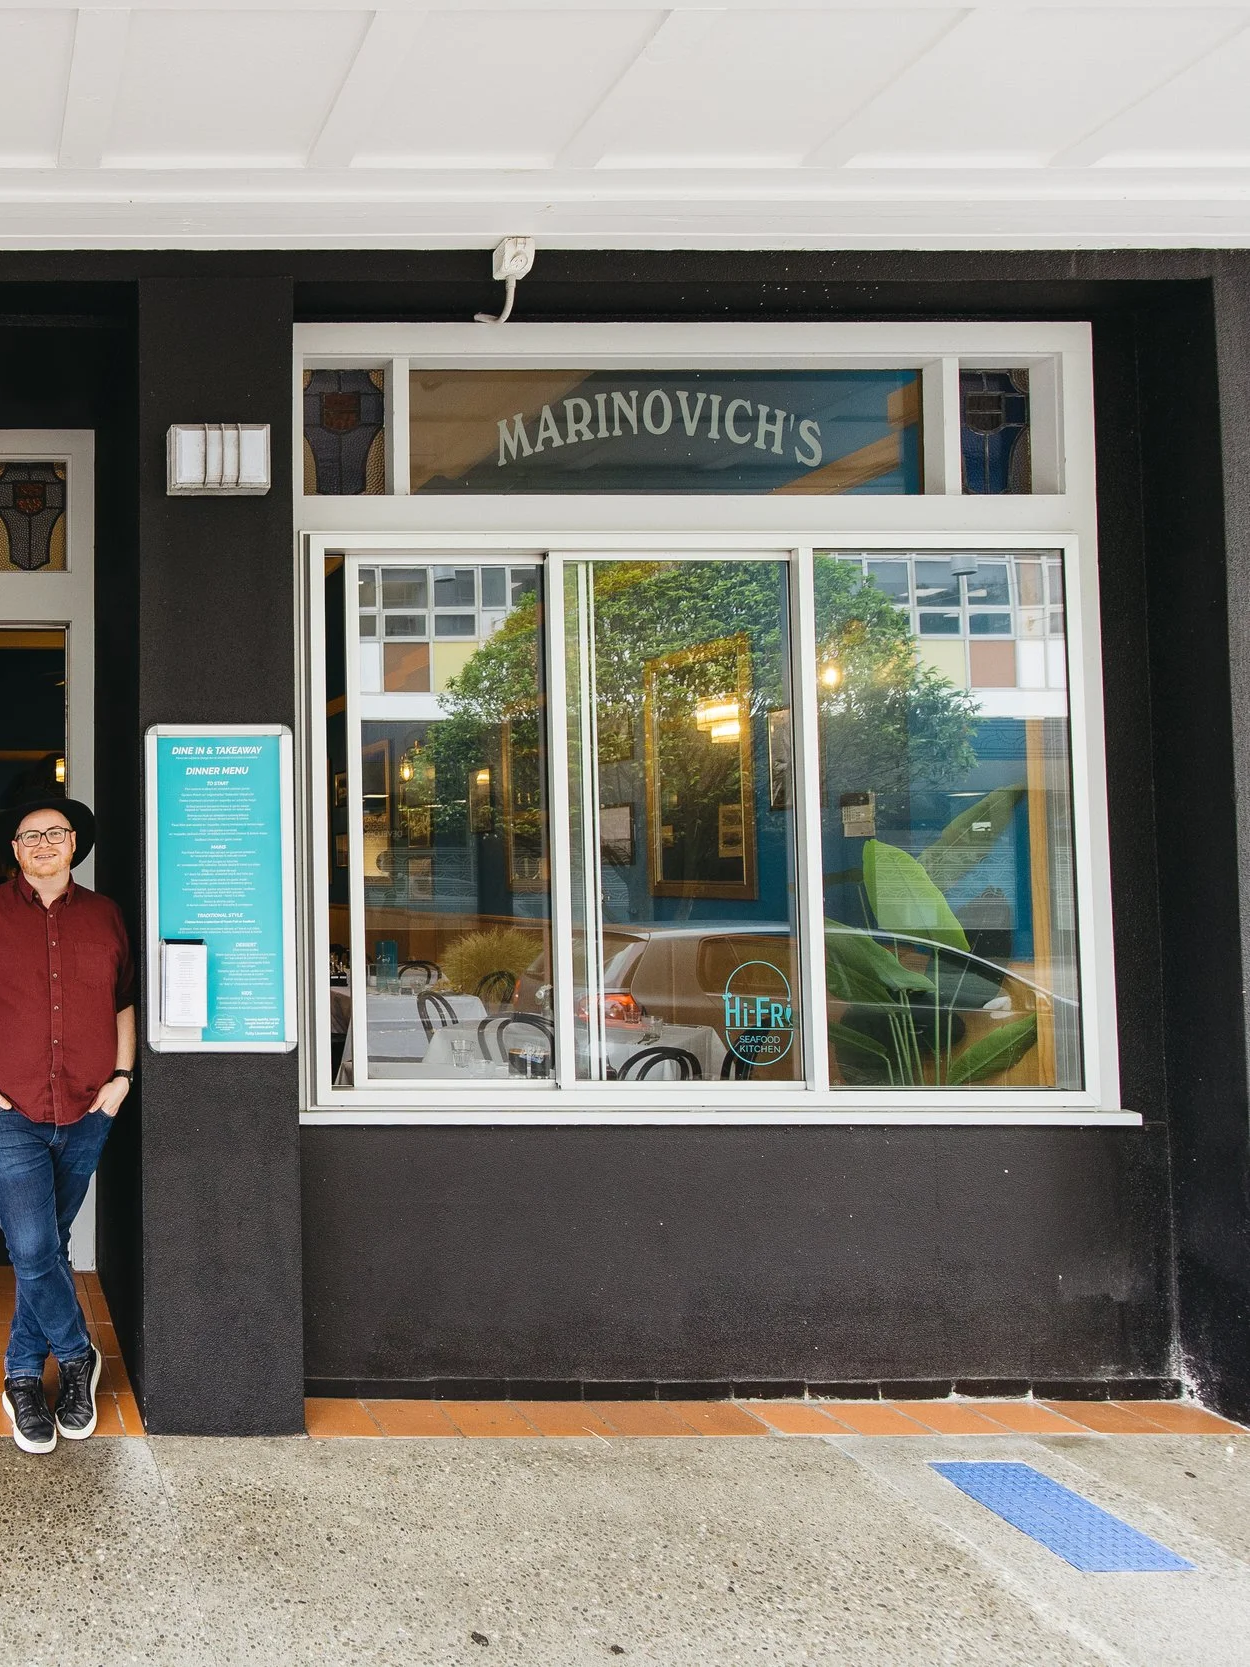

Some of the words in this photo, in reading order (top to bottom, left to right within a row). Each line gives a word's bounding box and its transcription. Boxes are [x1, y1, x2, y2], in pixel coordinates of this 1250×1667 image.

[497, 390, 824, 468] MARINOVICH'S
[172, 746, 194, 755] DINE
[195, 746, 205, 755] IN
[206, 746, 213, 755] &
[215, 746, 262, 755] TAKEAWAY
[186, 767, 220, 775] DINNER
[222, 766, 249, 775] MENU
[739, 1035, 781, 1044] SEAFOOD
[739, 1045, 781, 1053] KITCHEN
